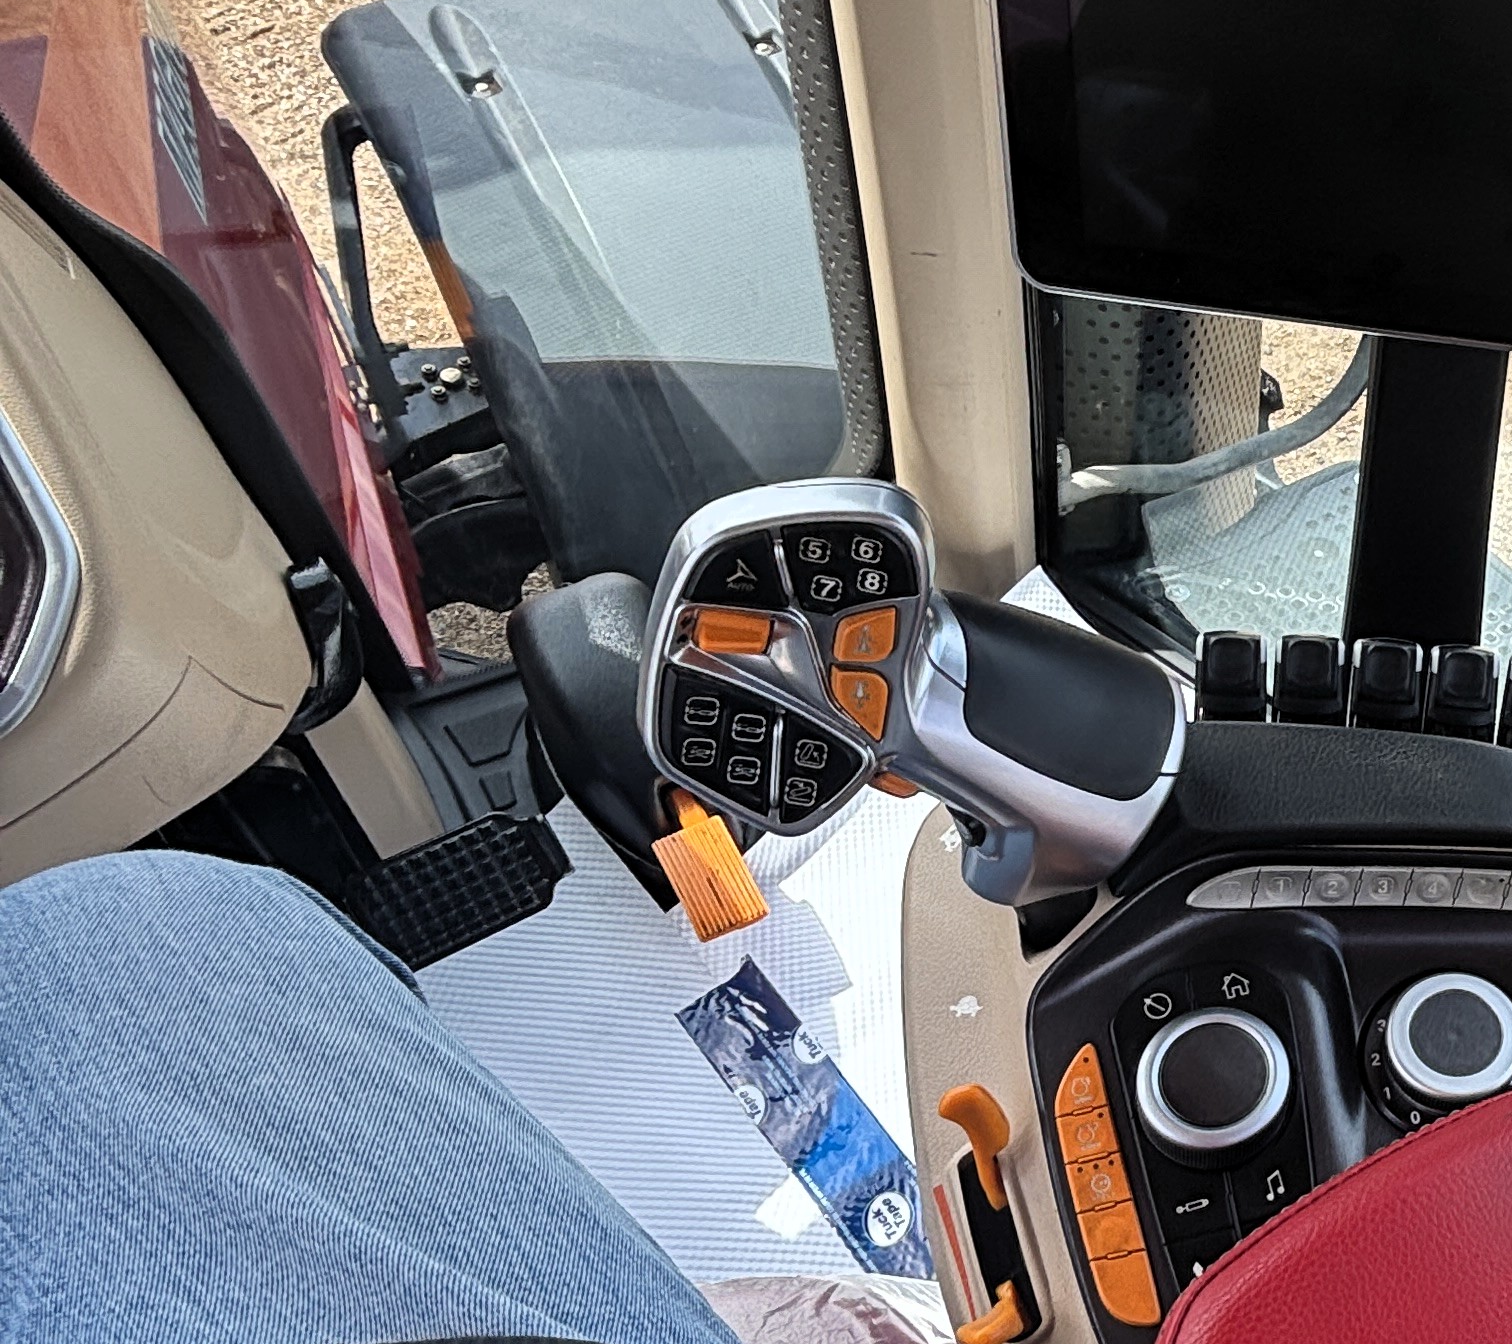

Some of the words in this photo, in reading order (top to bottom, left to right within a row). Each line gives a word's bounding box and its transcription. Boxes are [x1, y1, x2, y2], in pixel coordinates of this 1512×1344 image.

[808, 542, 823, 559] 5
[859, 541, 875, 559] 6
[819, 579, 836, 598] 7
[864, 573, 880, 591] 8
[1327, 880, 1338, 895] 2
[1377, 880, 1389, 895] 3
[1427, 880, 1439, 895] 4
[798, 1030, 824, 1060] Tuck
[1371, 1053, 1382, 1067] 2
[1383, 1086, 1392, 1101] 1
[739, 1090, 763, 1120] Tape
[1410, 1110, 1421, 1126] 0
[881, 1196, 906, 1229] Tape
[871, 1206, 897, 1241] Tuck
